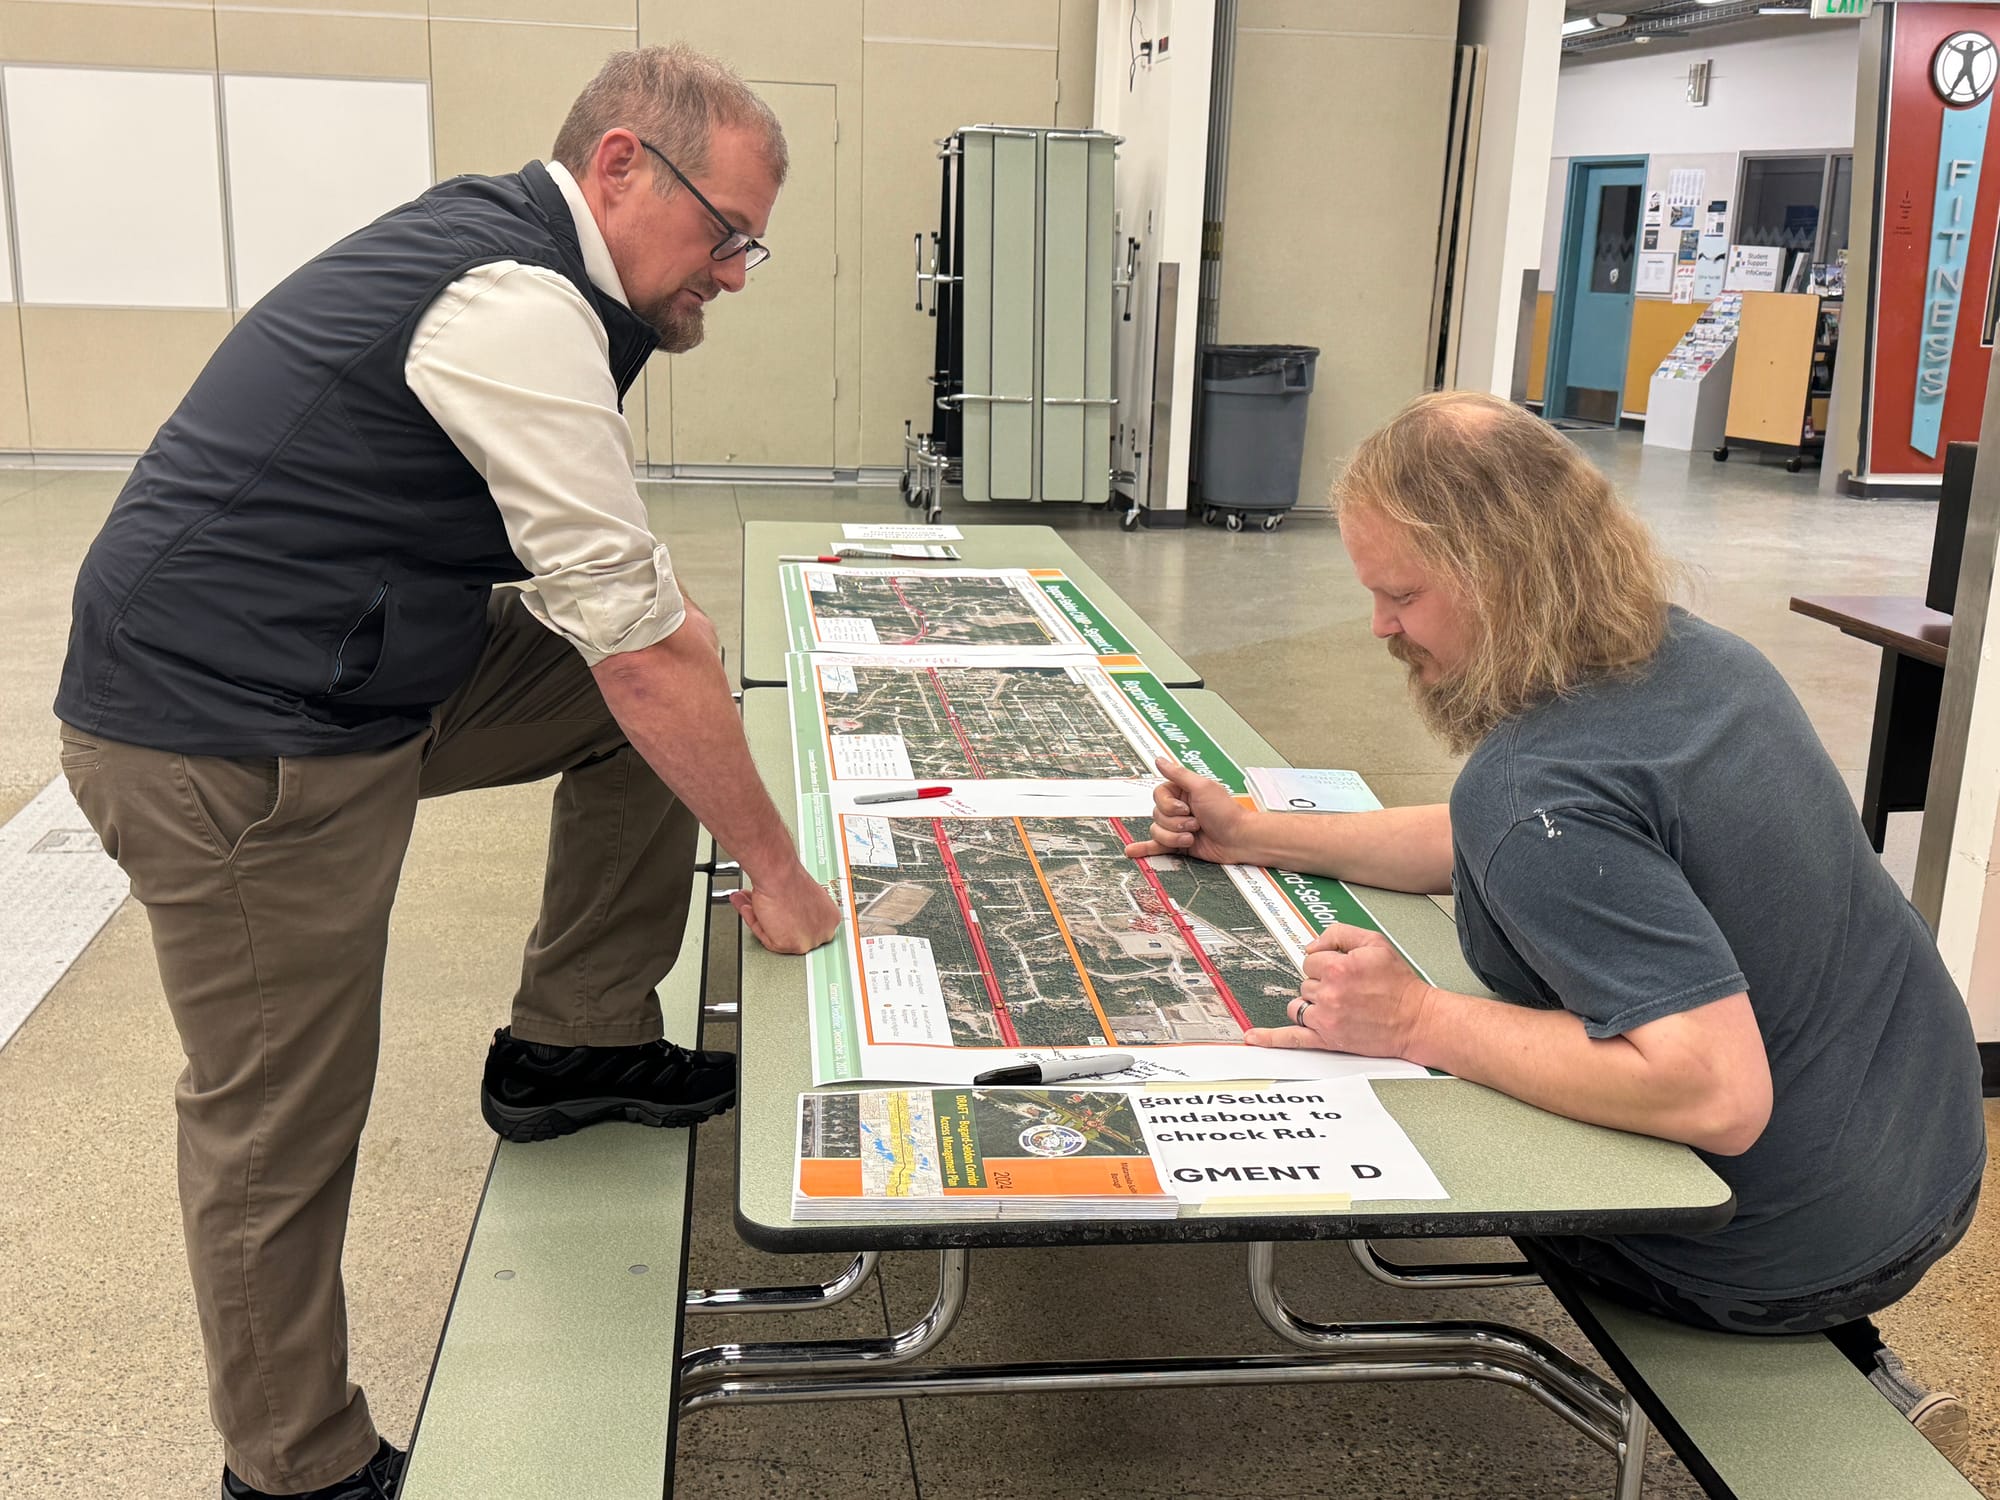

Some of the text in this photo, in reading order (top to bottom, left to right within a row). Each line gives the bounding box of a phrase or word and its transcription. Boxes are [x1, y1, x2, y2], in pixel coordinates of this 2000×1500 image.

[1921, 160, 1976, 397] FITNESS
[1157, 722, 1190, 744] CAMP
[1277, 869, 1338, 927] rd-Seldon
[956, 1095, 968, 1114] DRAFT
[1139, 1094, 1325, 1109] gard/Seldon
[1310, 1111, 1342, 1120] to
[957, 1121, 976, 1164] Bogard-Seldon
[1157, 1128, 1327, 1142] chrock Rd.
[940, 1115, 960, 1187] Access Management Plan
[965, 1164, 980, 1186] Corridor
[994, 1171, 1013, 1189] 2024
[1166, 1165, 1382, 1183] GMENT D
